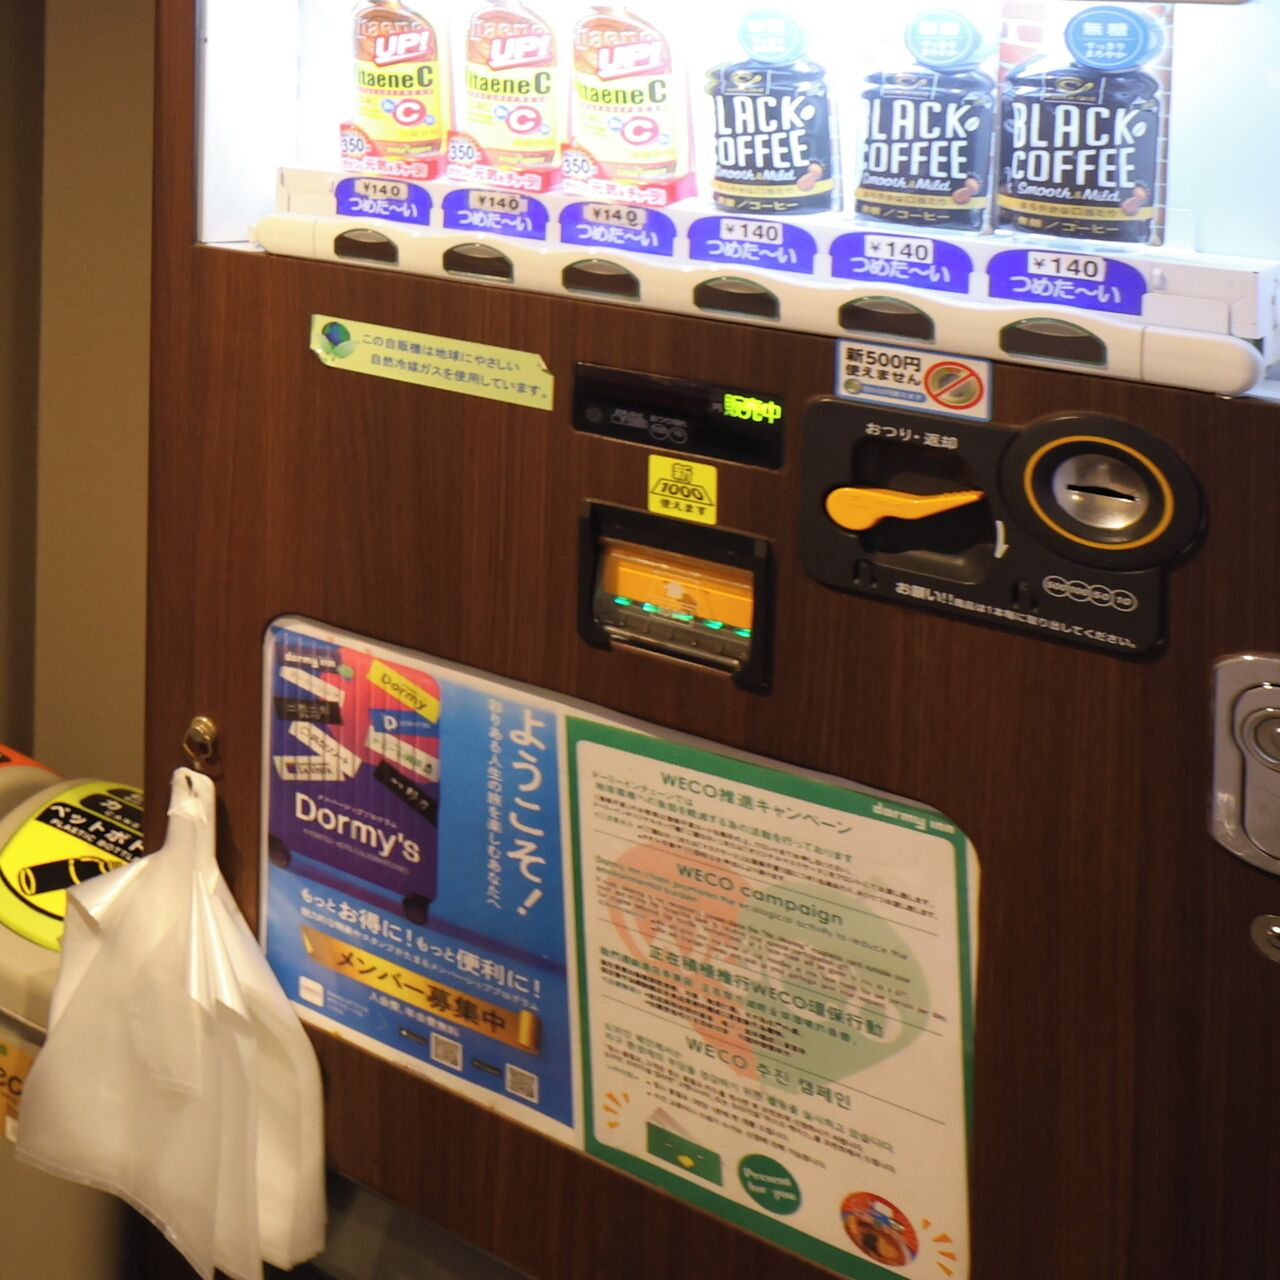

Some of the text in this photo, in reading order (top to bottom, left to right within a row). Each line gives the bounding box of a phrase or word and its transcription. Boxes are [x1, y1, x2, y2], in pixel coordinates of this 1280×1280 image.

[375, 31, 429, 59] UP!
[491, 35, 550, 65] UP!
[599, 42, 663, 73] UP!
[714, 95, 806, 136] LACK
[865, 97, 972, 140] LACK
[1012, 102, 1140, 148] BLACK
[715, 128, 811, 169] OFFEE
[1011, 146, 1136, 188] COFFEE
[364, 182, 401, 197] ¥140
[479, 196, 519, 211] ¥140
[1017, 181, 1073, 200] Smooth
[592, 207, 638, 225] ¥140
[725, 223, 778, 242] ¥140
[869, 239, 928, 261] ¥140
[1032, 257, 1098, 279] ¥140
[845, 346, 922, 373] 新500円
[845, 364, 922, 387] 使えません
[659, 481, 704, 502] 1000
[659, 499, 707, 517] 使えます
[380, 672, 429, 712] Dormy
[48, 816, 98, 843] PLASTIC
[49, 804, 144, 852] ペットボト
[293, 791, 422, 864] Dormy's
[676, 862, 845, 927] WECO campaign
[336, 950, 507, 1033] メンバー募集中
[685, 1035, 750, 1071] WECO
